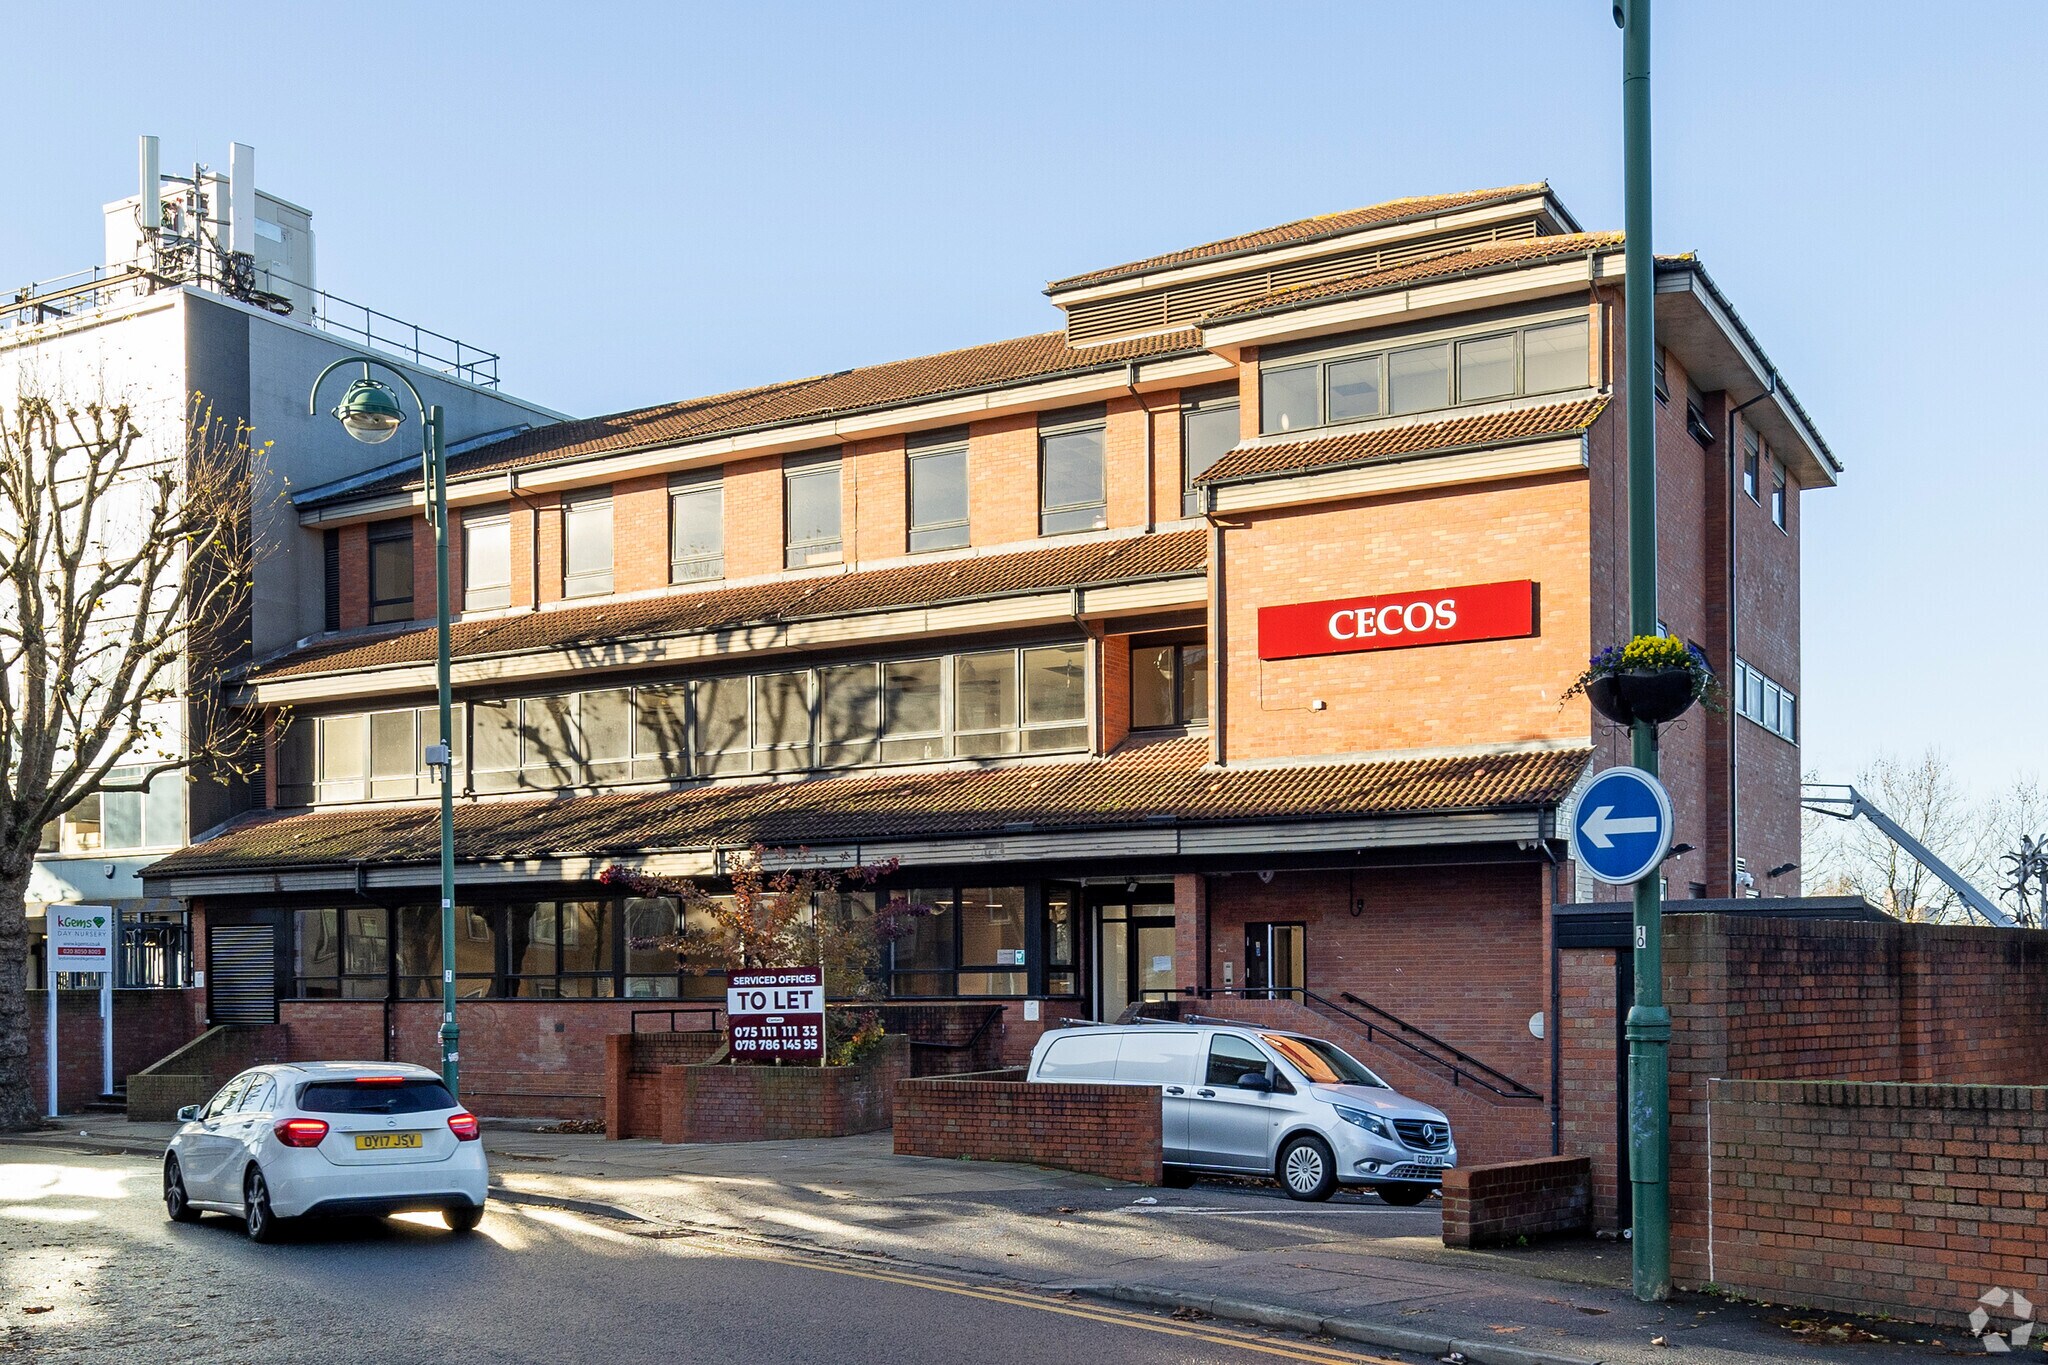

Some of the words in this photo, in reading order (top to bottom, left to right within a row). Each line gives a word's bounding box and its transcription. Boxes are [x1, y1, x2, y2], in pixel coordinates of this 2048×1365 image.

[1328, 599, 1457, 640] CECOS
[57, 915, 92, 928] kGems
[1637, 926, 1644, 948] 10
[733, 976, 777, 985] SERVICED
[778, 974, 816, 984] OFFICES
[736, 991, 766, 1010] TO
[774, 990, 814, 1010] LET
[734, 1026, 758, 1038] 075
[760, 1026, 777, 1037] 111
[781, 1026, 798, 1037] 111
[802, 1026, 818, 1036] 33
[734, 1040, 756, 1050] 078
[758, 1040, 780, 1050] 786
[782, 1039, 802, 1050] 145
[803, 1039, 818, 1050] 95
[364, 1135, 390, 1147] OY17
[394, 1134, 416, 1146] JSV
